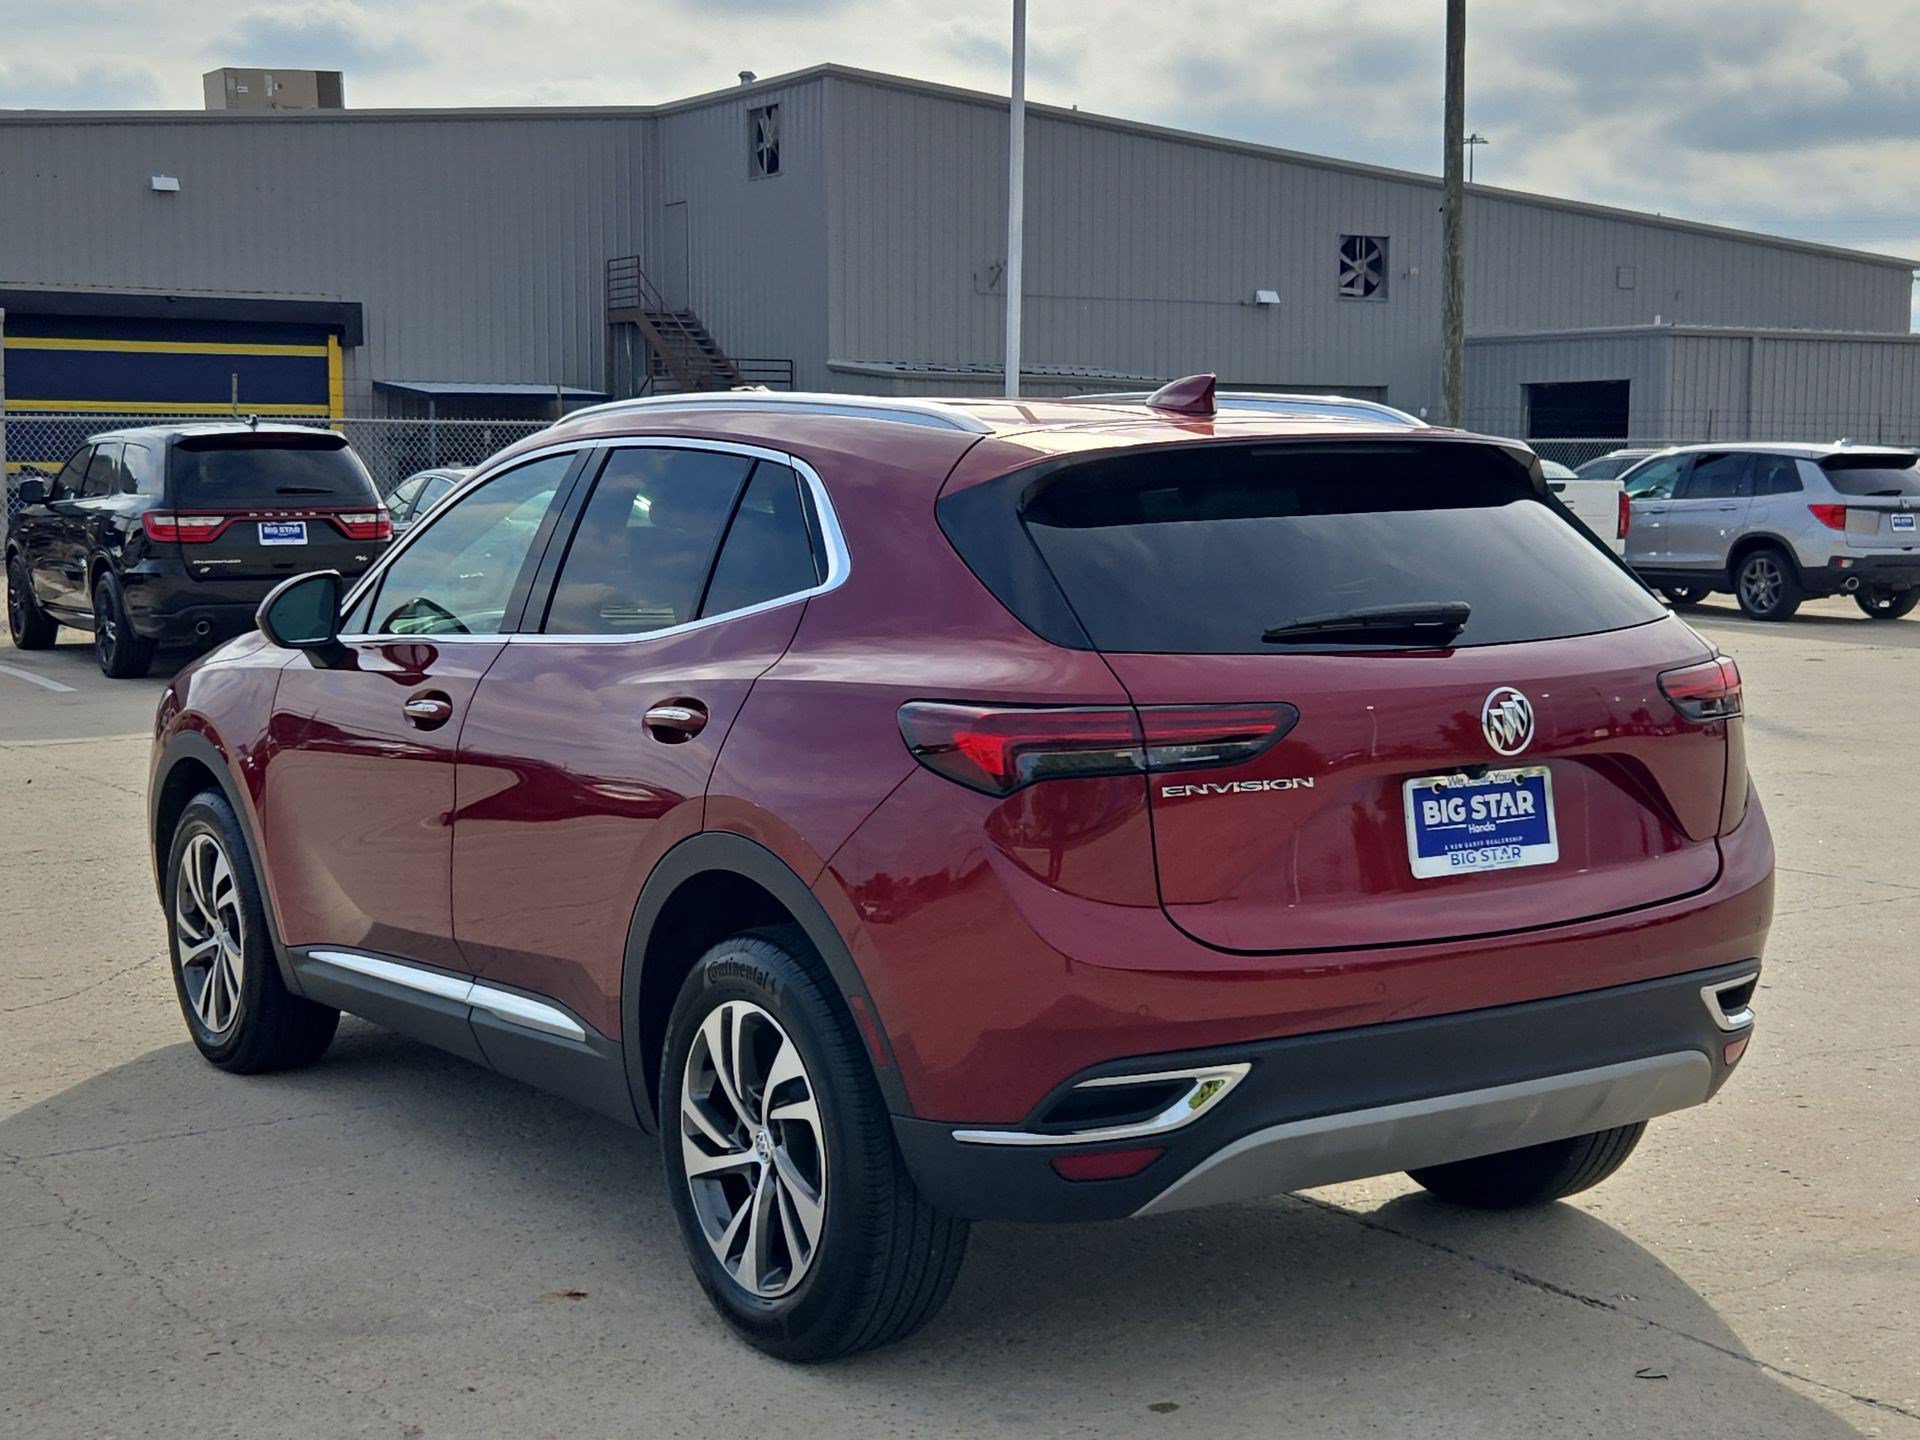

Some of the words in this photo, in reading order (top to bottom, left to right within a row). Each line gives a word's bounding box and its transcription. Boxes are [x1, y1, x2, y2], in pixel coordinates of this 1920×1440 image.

[263, 526, 278, 534] BIG
[279, 526, 301, 534] STAR
[1161, 777, 1315, 798] ENVISION
[1422, 797, 1467, 826] BIG
[1470, 790, 1536, 820] STAR
[1468, 821, 1496, 834] Honda
[1485, 835, 1524, 846] DEALERSHIP
[1450, 851, 1477, 866] BIG
[1480, 846, 1522, 862] STAR
[707, 957, 769, 990] Continental
